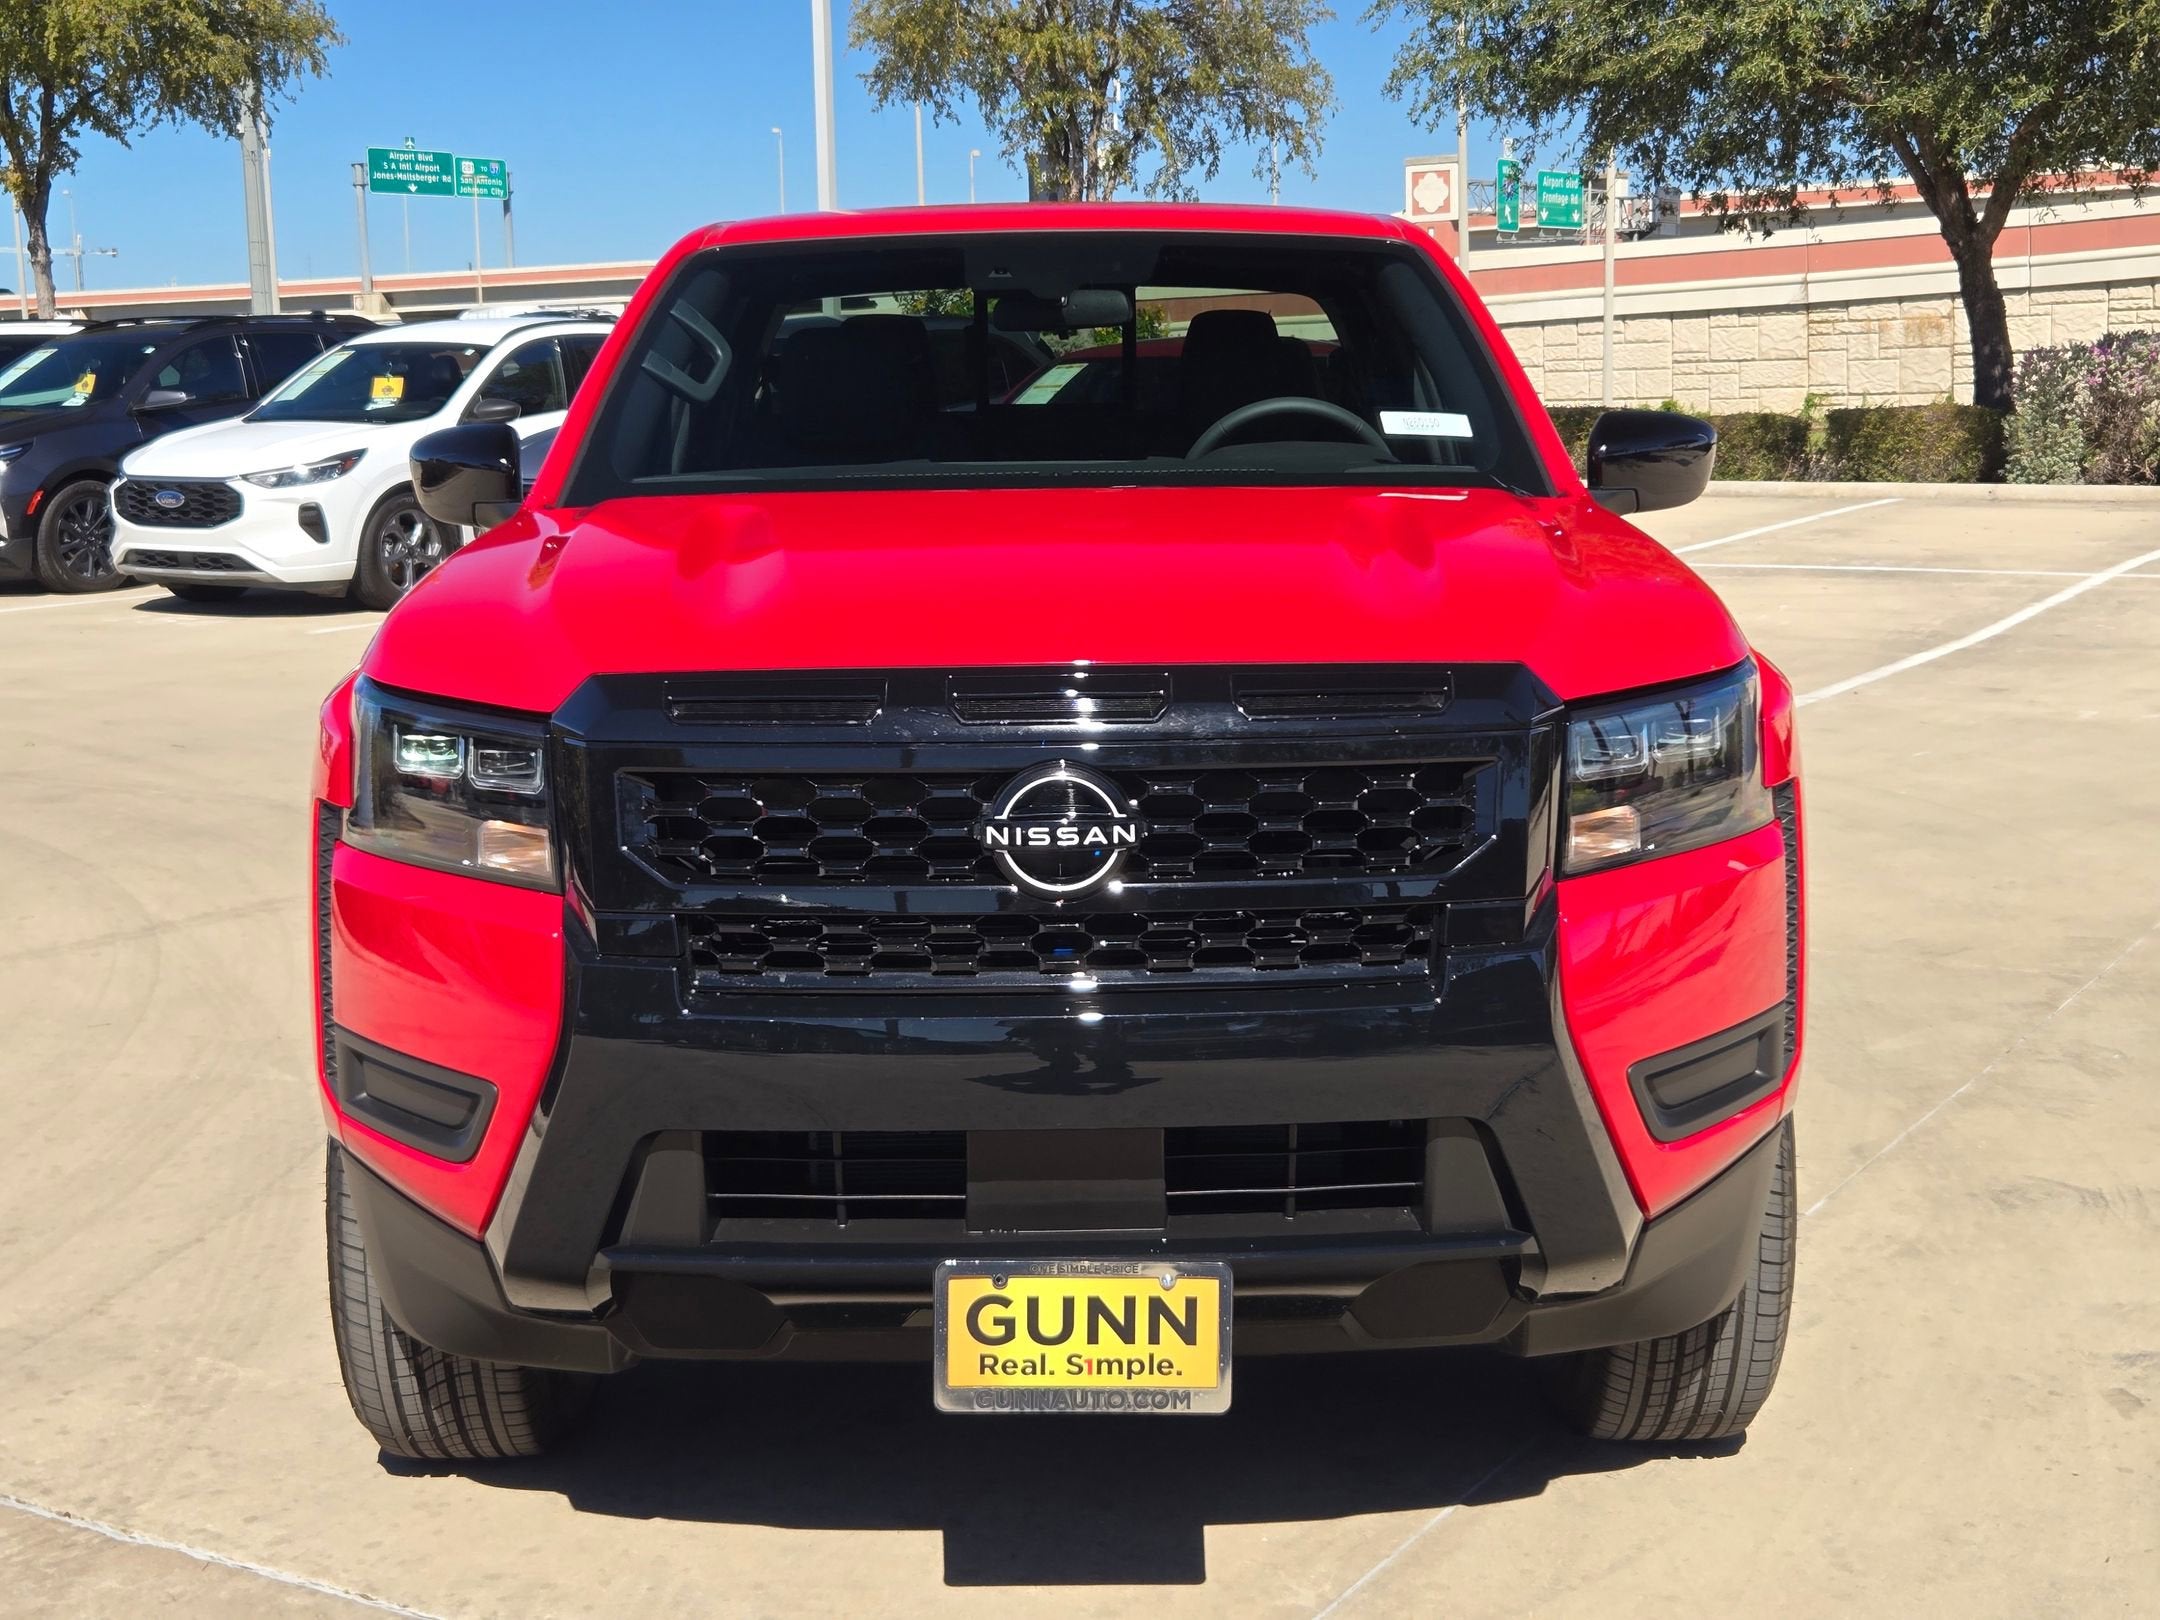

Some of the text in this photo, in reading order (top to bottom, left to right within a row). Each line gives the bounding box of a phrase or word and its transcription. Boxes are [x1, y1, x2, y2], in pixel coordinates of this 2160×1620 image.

[389, 152, 433, 162] Airport Blvd
[383, 162, 440, 173] S A Intl Airport
[373, 172, 452, 184] Jones-Maltsberger Rd
[476, 177, 503, 186] Antonio
[1543, 176, 1564, 189] Airport
[491, 187, 504, 198] City
[1542, 191, 1579, 206] Frontage Rd
[986, 824, 1136, 846] NISSAN
[1029, 1264, 1139, 1274] ONE SIMPLE PRICE
[966, 1293, 1198, 1346] GUNN
[979, 1353, 1055, 1376] Real.
[975, 1388, 1192, 1410] GUNNAUTO.COM
